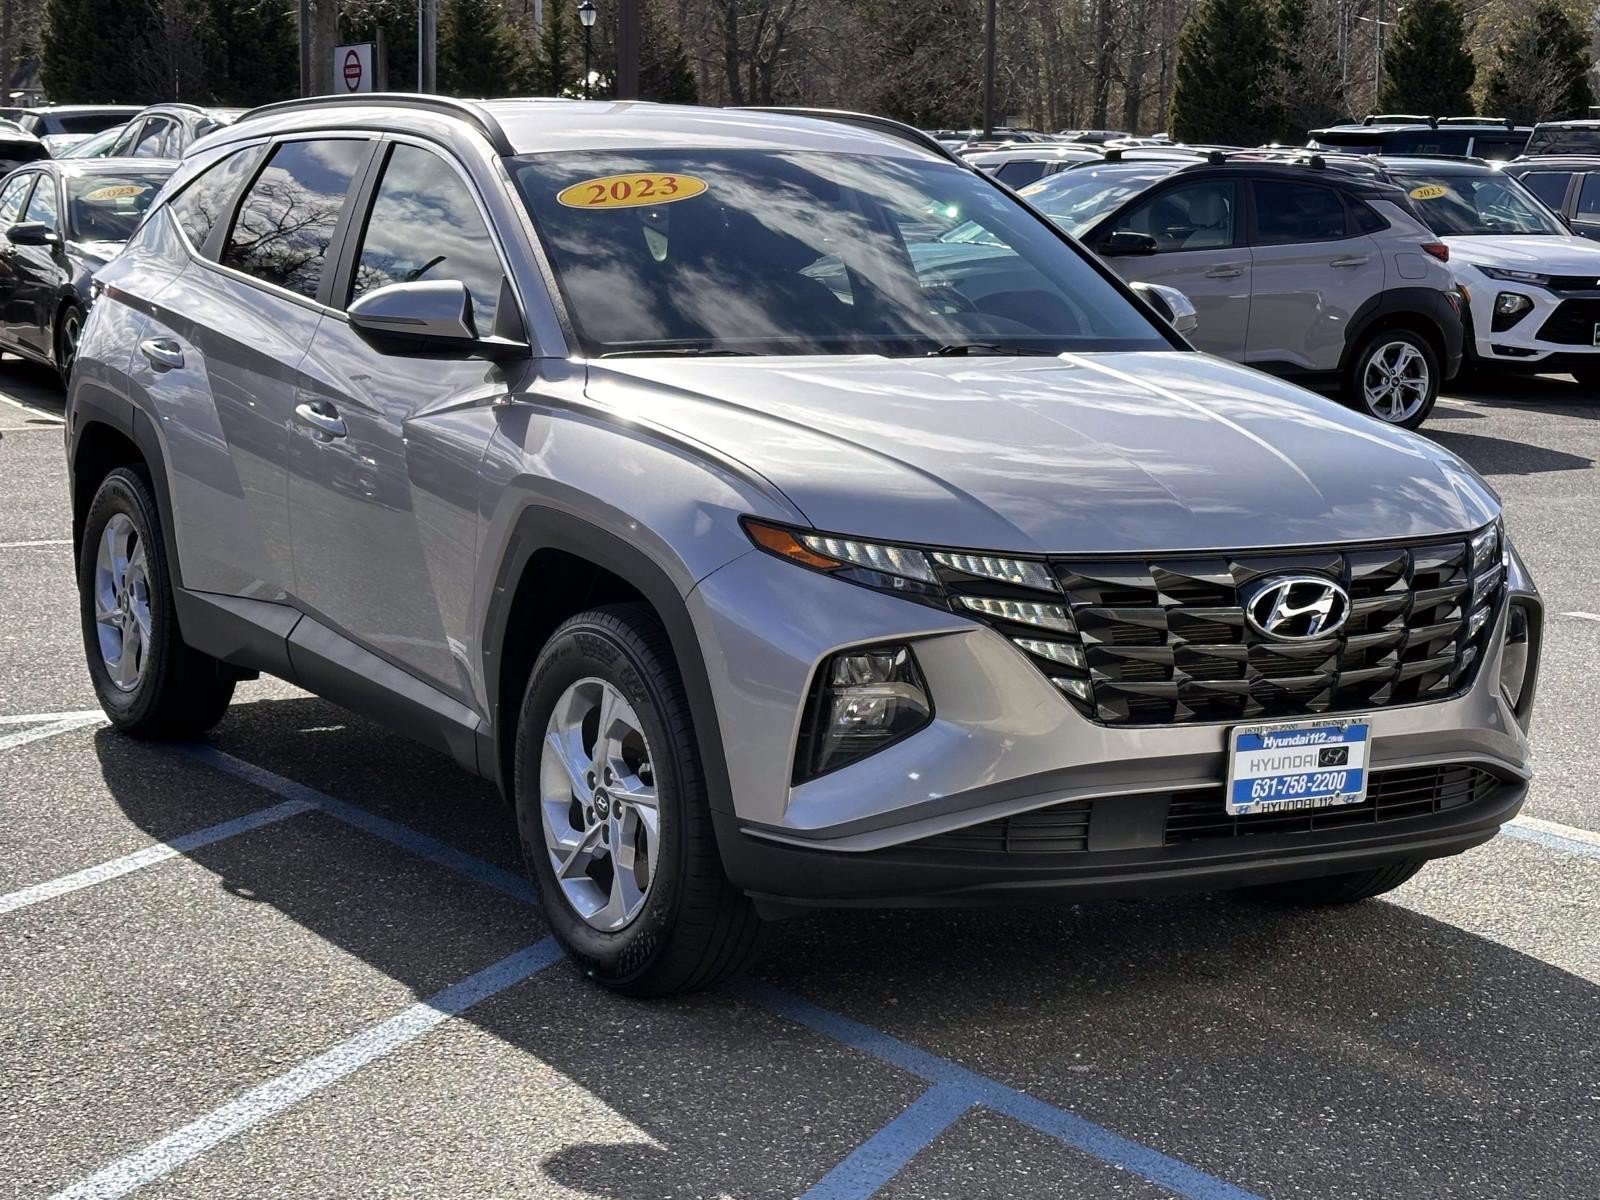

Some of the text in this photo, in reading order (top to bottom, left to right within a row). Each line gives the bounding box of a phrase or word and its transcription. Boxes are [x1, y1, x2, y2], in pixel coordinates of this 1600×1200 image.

[96, 187, 134, 199] 2023
[588, 177, 678, 204] 2023
[1418, 187, 1442, 198] 2023
[1250, 754, 1317, 773] HYUNDAI
[1252, 772, 1346, 798] 631-758-2200
[1261, 796, 1334, 812] HYUNDAI 112
